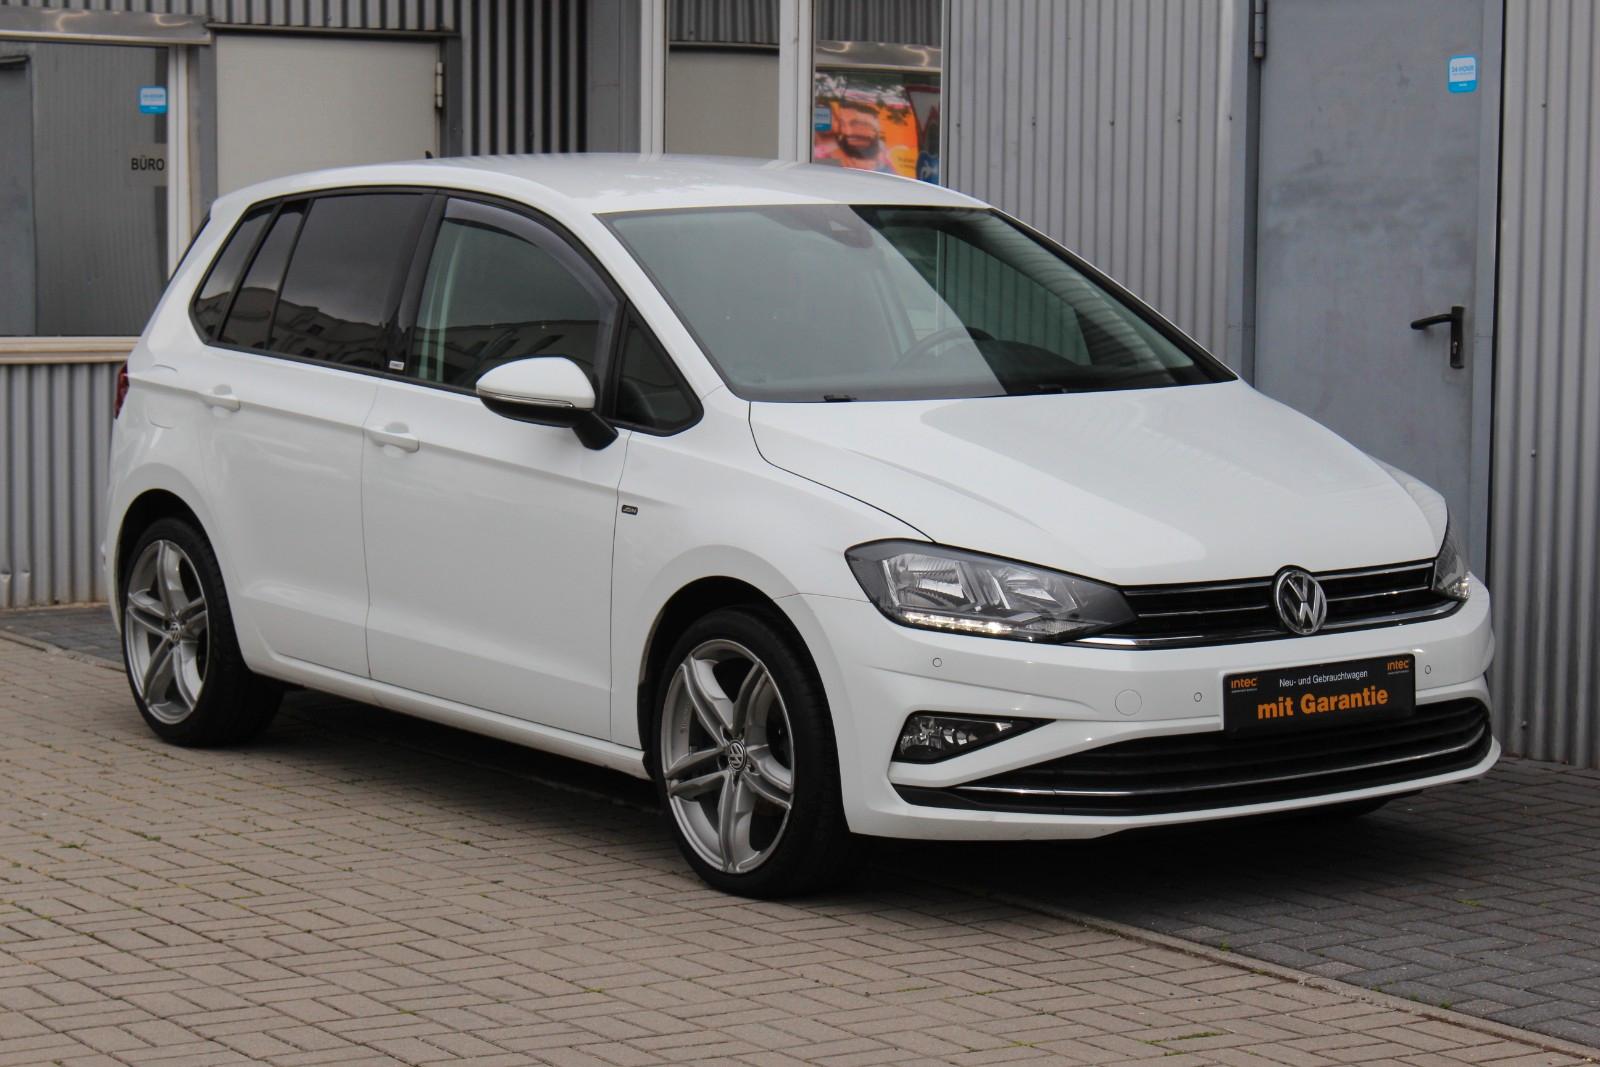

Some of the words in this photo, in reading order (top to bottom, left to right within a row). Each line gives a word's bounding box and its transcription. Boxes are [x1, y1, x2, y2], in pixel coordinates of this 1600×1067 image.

[131, 154, 165, 171] BÜRO
[1279, 679, 1297, 688] Neu-
[1298, 676, 1311, 686] und
[1312, 670, 1368, 684] Gebrauchtwagen
[1257, 696, 1294, 720] mit
[1300, 684, 1389, 714] Garantie
